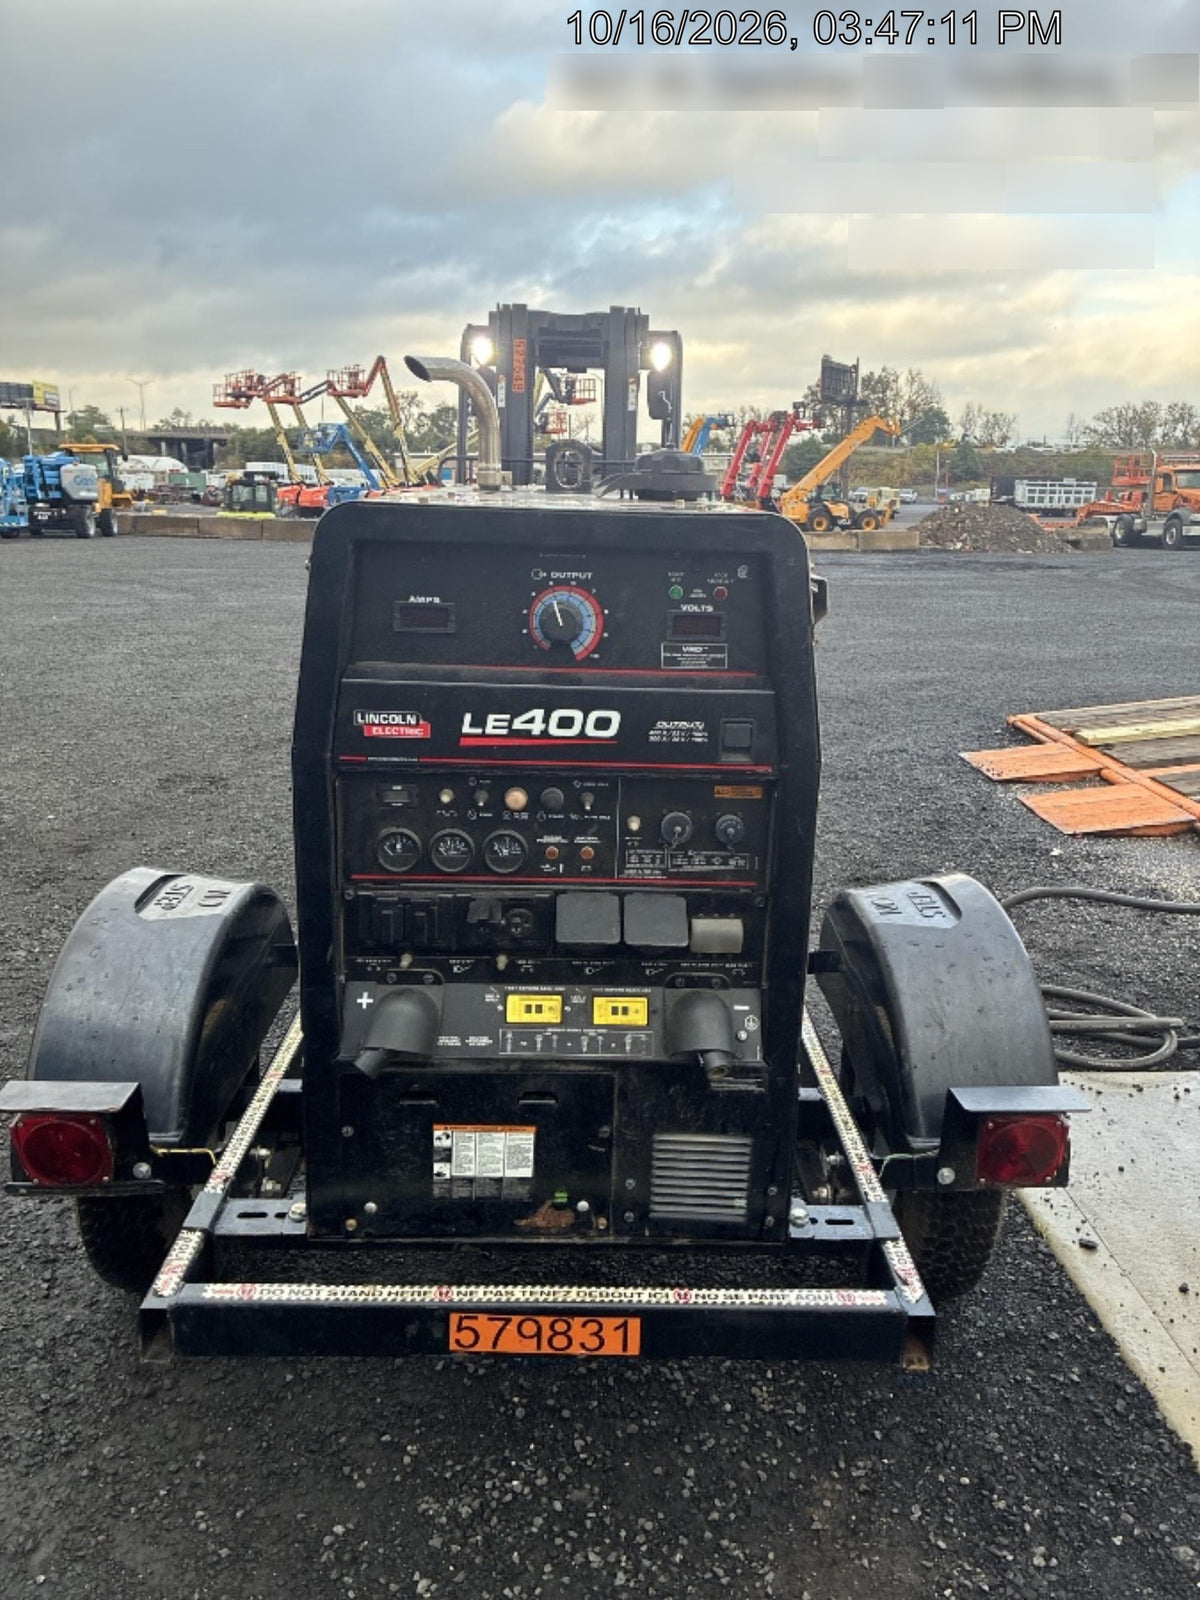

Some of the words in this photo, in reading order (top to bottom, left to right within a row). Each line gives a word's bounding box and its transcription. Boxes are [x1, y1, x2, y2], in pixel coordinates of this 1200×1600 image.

[550, 571, 593, 580] OUTPUT
[408, 595, 440, 604] AMPS
[680, 603, 714, 613] VOLTS
[356, 712, 417, 725] LINCOLN
[461, 708, 622, 738] LE400
[371, 726, 424, 736] ELECTRIC
[259, 1287, 285, 1297] DO
[288, 1287, 323, 1297] NOT
[326, 1288, 383, 1298] STAND
[386, 1289, 433, 1298] HERE
[456, 1290, 480, 1298] NE
[482, 1290, 515, 1298] PAS
[519, 1289, 573, 1298] TENEZ
[576, 1290, 644, 1299] DEBOUT
[648, 1291, 670, 1299] ICI
[694, 1292, 719, 1300] NO
[722, 1292, 744, 1301] SE
[796, 1293, 834, 1302] AQUI
[454, 1315, 629, 1353] 579831
